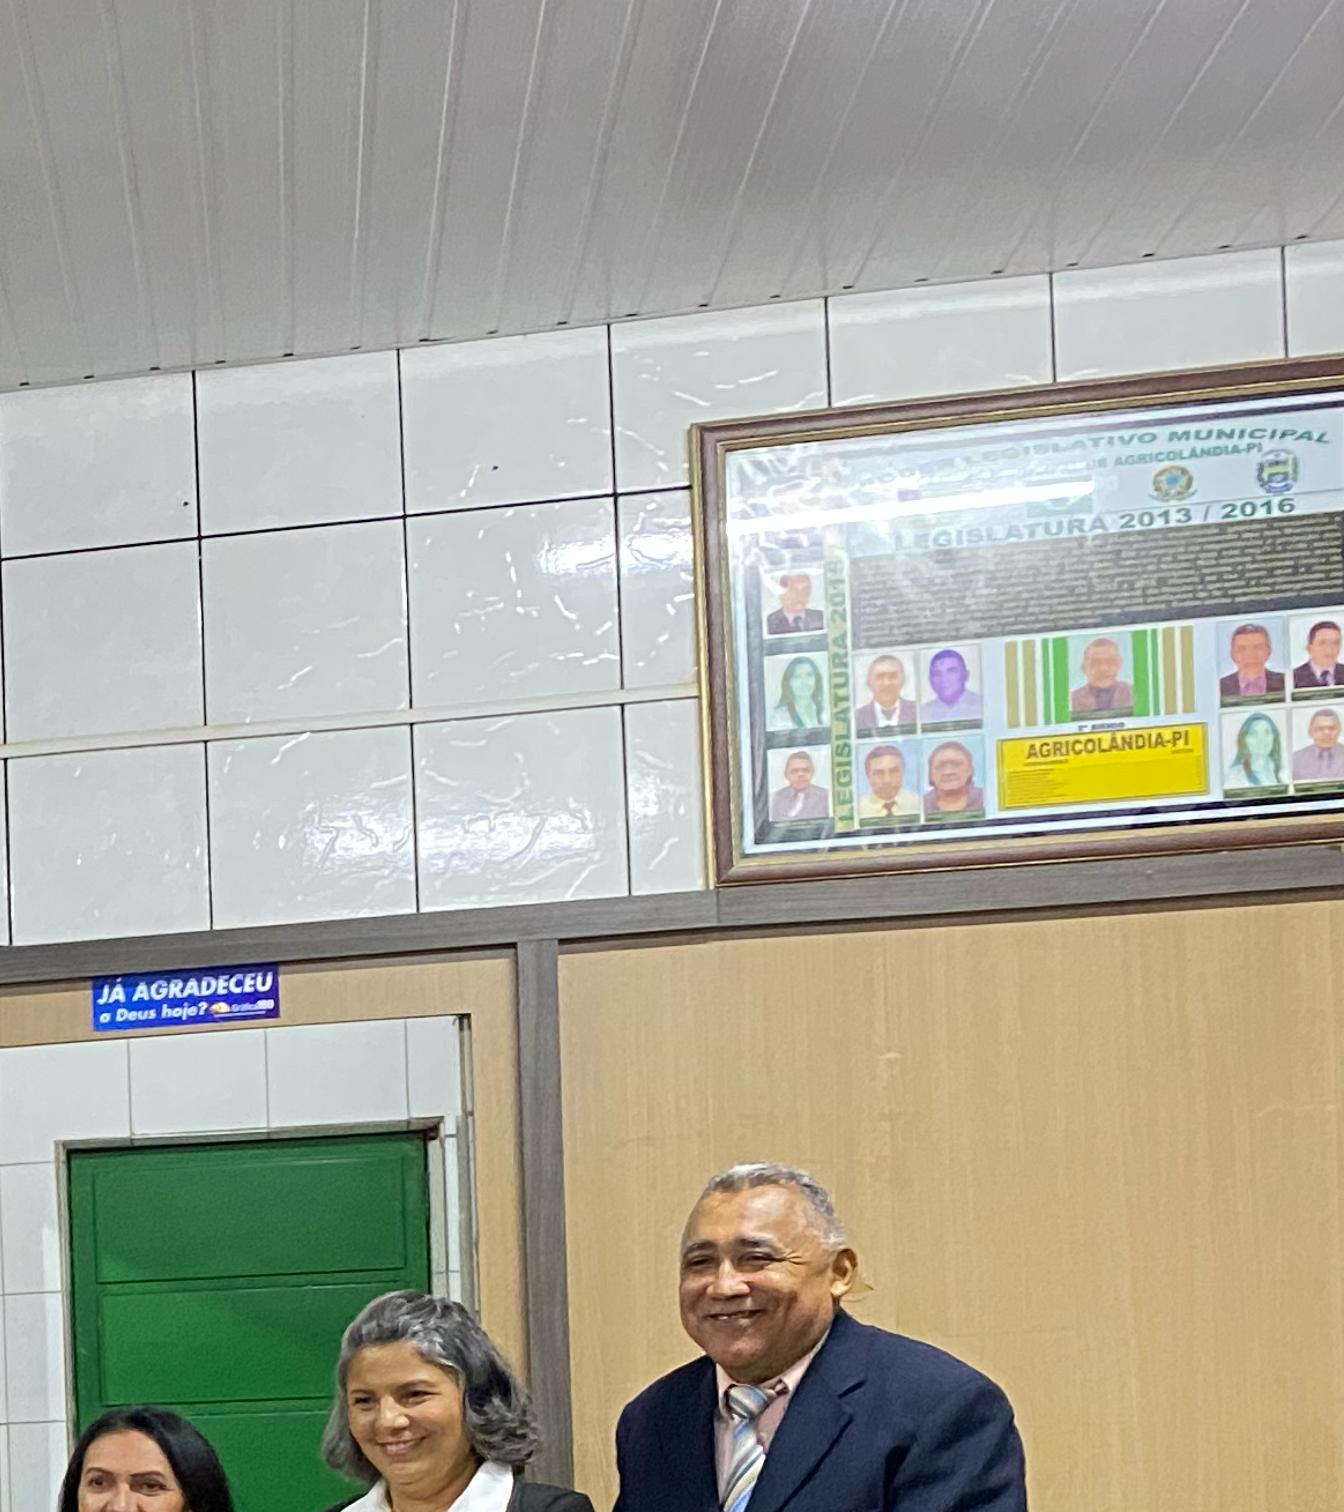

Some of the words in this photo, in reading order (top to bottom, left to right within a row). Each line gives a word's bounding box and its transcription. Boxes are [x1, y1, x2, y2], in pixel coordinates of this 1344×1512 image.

[1167, 426, 1332, 444] MUNICIPAL
[1119, 507, 1193, 530] 2013
[1201, 505, 1213, 524] /
[1221, 497, 1297, 520] 2016
[831, 634, 855, 824] LEGISLATURA
[1026, 730, 1190, 760] AGRICOLÂNDIA-PI
[97, 977, 126, 1005] JÁ
[132, 971, 274, 1002] AGRADECEU
[115, 1007, 157, 1022] Deus
[162, 1001, 208, 1021] hoje?
